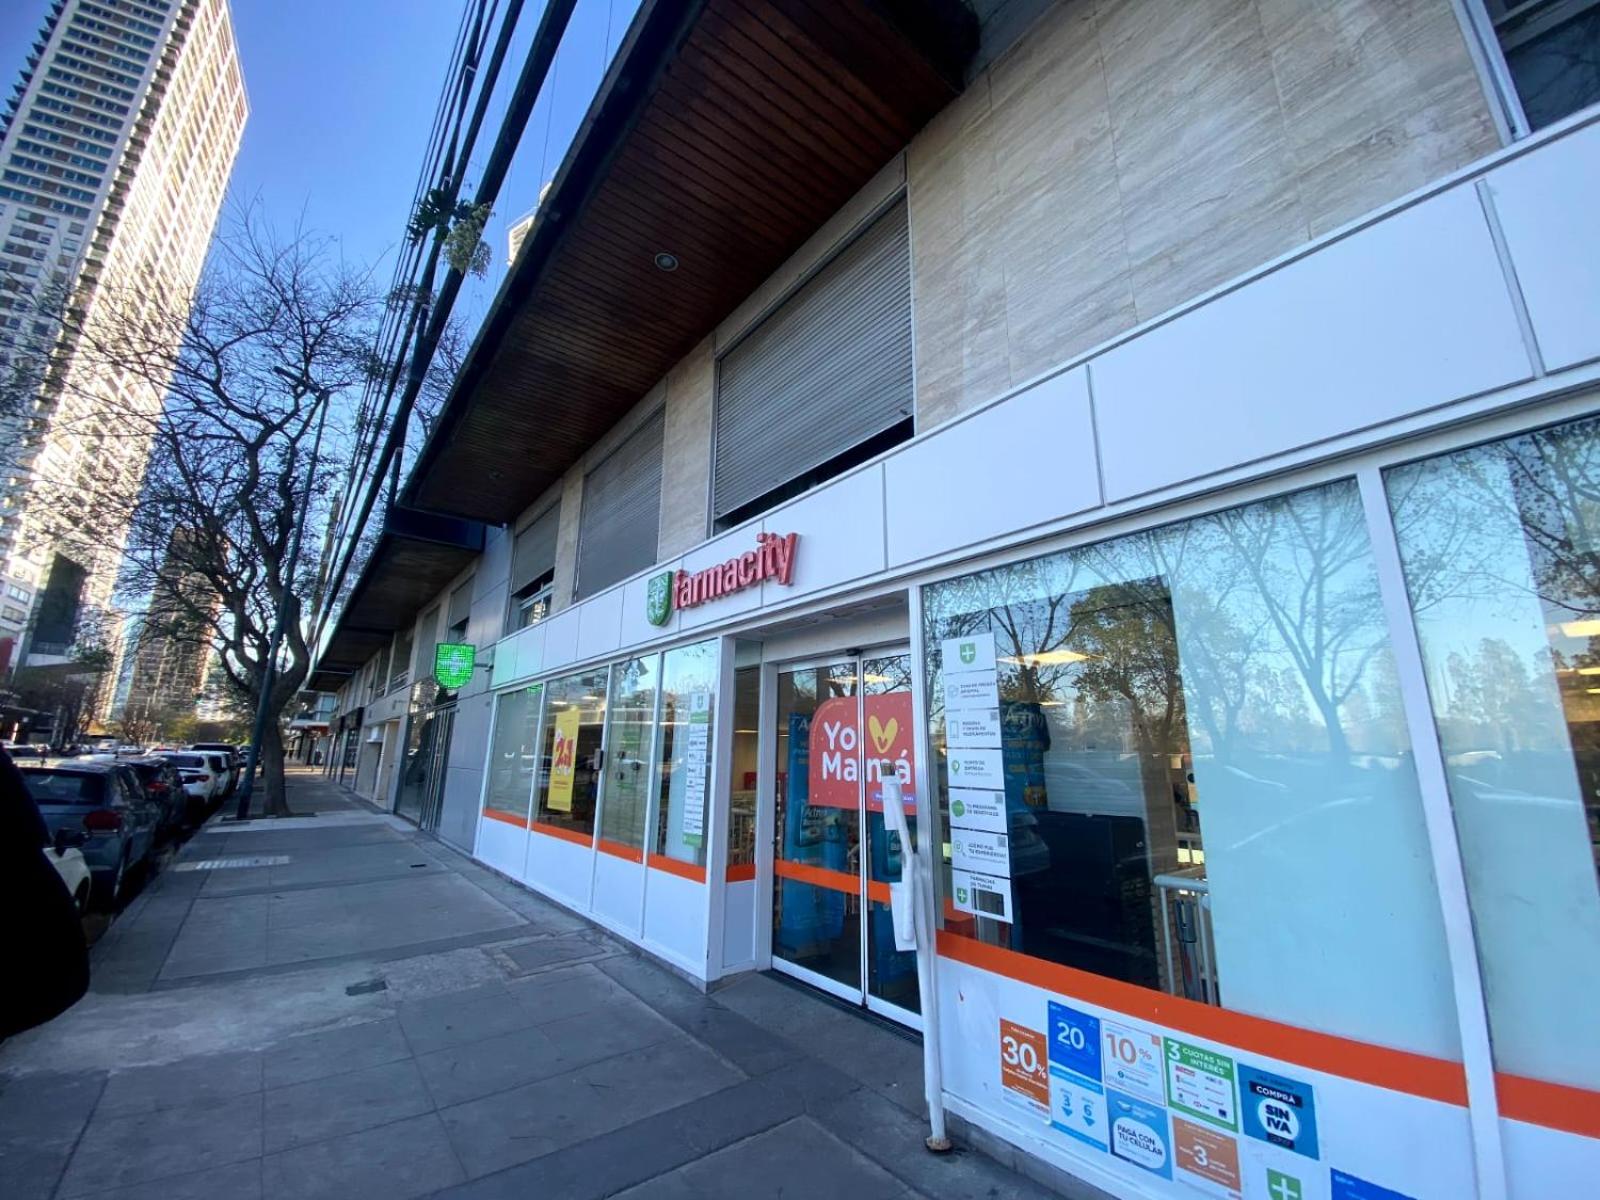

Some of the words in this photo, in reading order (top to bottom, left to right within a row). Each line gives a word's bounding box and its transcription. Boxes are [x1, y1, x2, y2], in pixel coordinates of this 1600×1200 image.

[673, 533, 798, 610] farmacity
[823, 720, 857, 751] Yo
[822, 748, 911, 785] Mamá
[1002, 1036, 1047, 1079] 30%
[1106, 1033, 1153, 1065] 10%
[1167, 1041, 1181, 1060] 3
[1182, 1047, 1215, 1064] CUOTAS
[1216, 1058, 1231, 1069] SIN
[1265, 1104, 1290, 1121] SIN
[1266, 1117, 1292, 1135] IVA
[1118, 1132, 1129, 1142] TU
[1138, 1134, 1156, 1146] CON
[1193, 1145, 1208, 1166] 3
